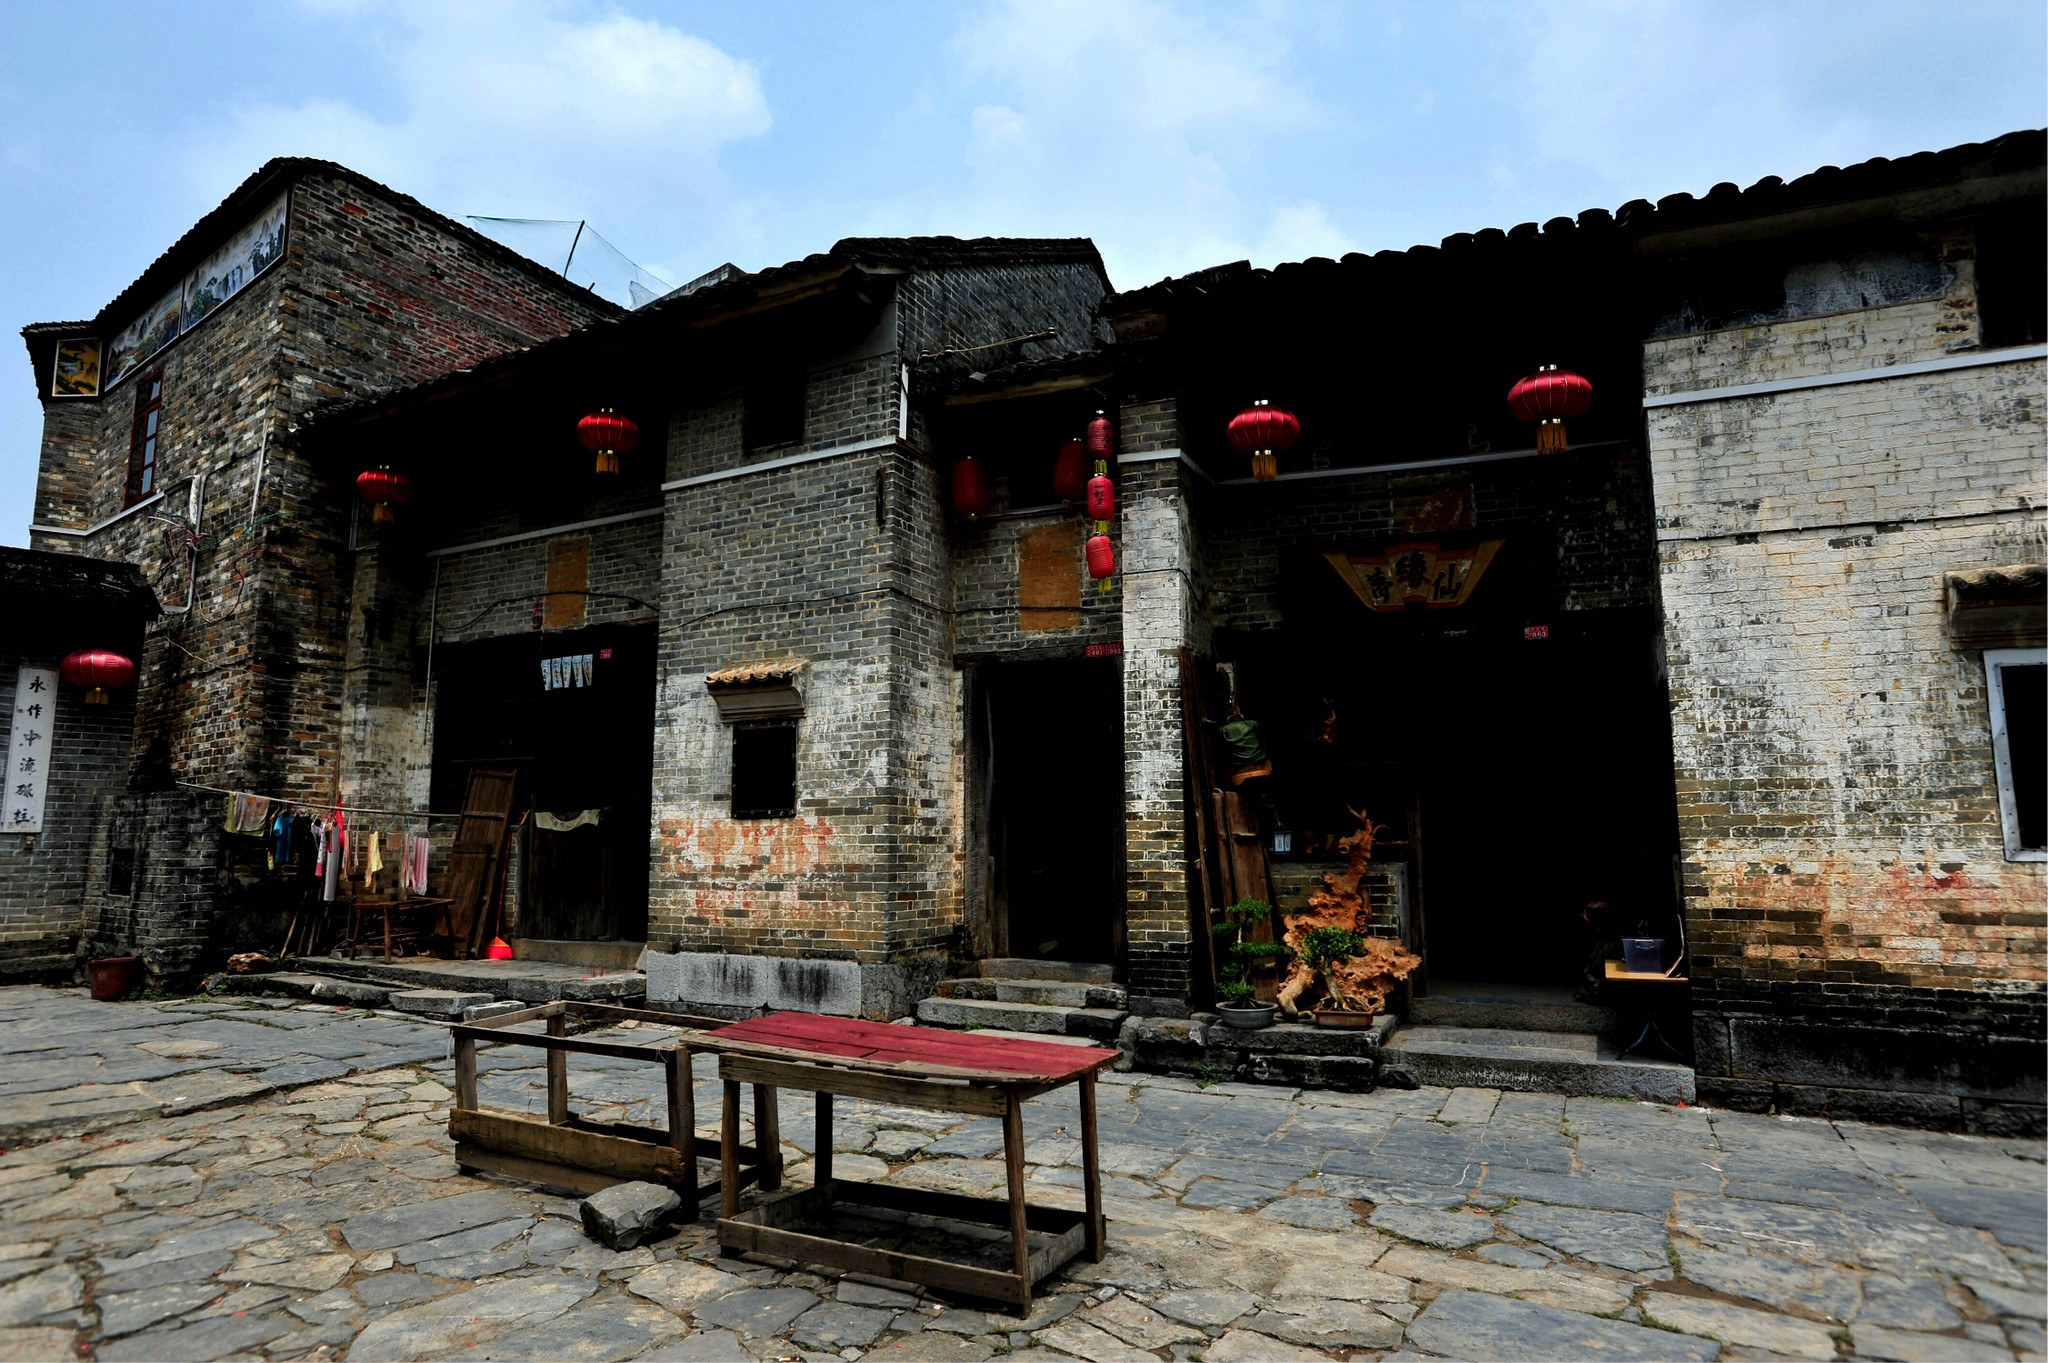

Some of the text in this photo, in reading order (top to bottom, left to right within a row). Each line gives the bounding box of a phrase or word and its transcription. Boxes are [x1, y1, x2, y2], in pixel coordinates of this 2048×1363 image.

[13, 676, 47, 824] 永作中流砥柱
